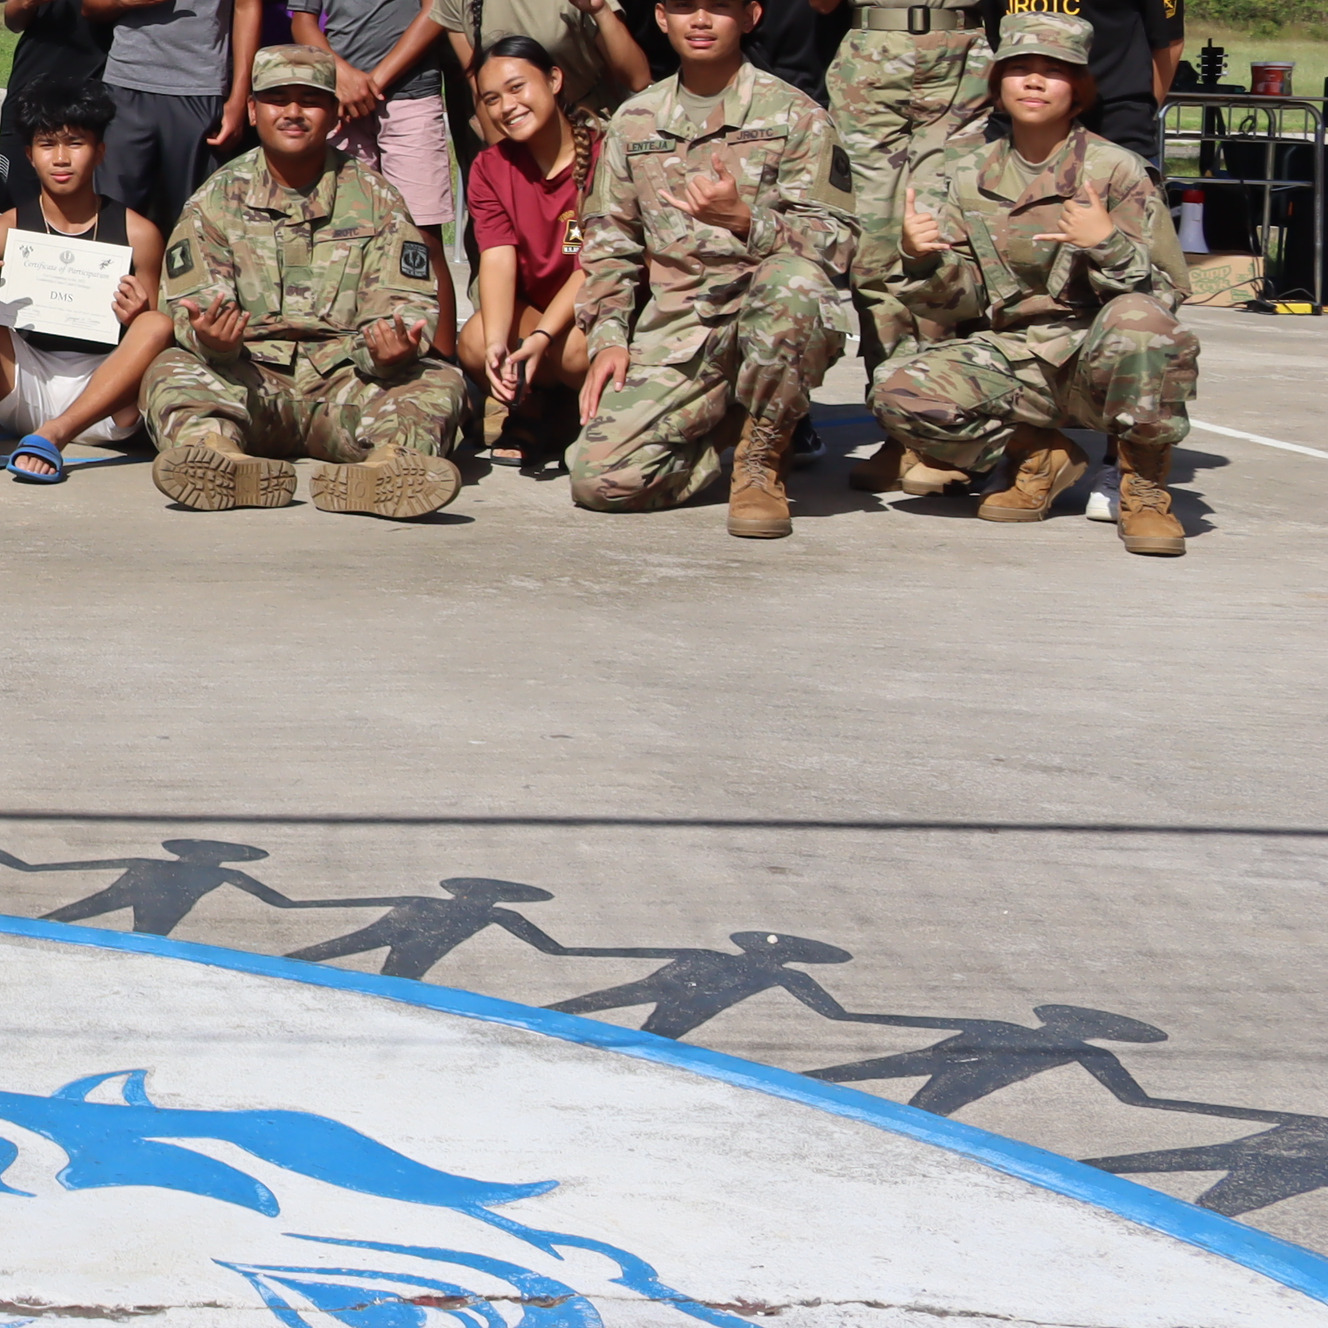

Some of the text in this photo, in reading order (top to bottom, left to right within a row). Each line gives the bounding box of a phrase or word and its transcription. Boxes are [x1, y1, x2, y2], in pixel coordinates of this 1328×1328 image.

[736, 127, 774, 140] JROTC
[627, 142, 668, 152] LENTEJA
[23, 259, 110, 280] Certificate of Participation
[50, 290, 74, 303] DMS
